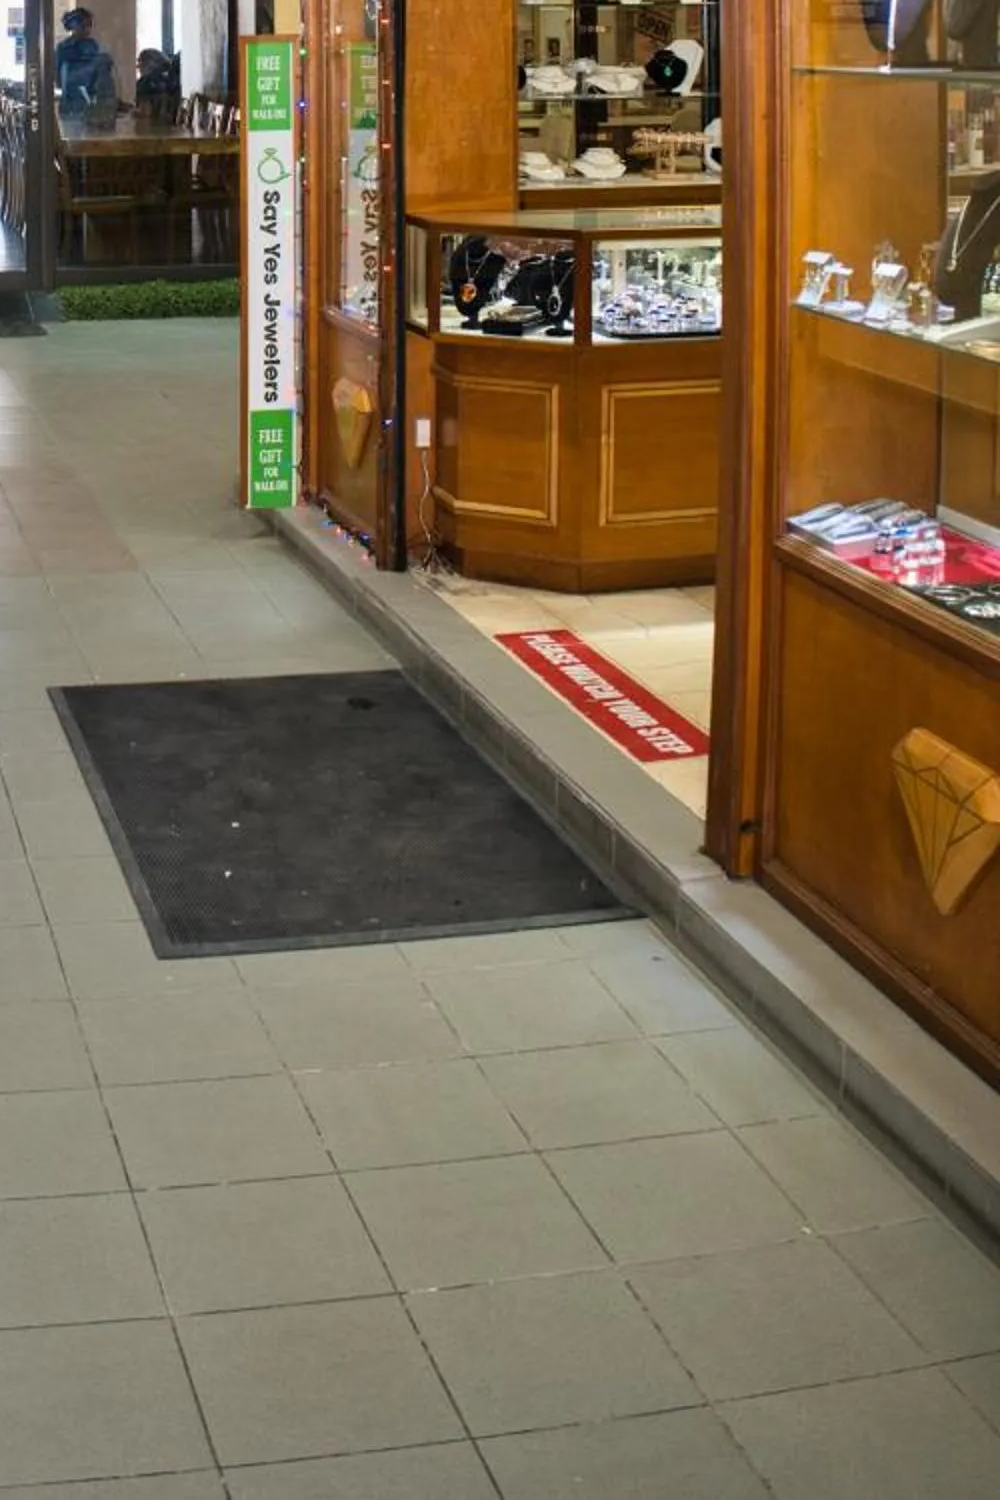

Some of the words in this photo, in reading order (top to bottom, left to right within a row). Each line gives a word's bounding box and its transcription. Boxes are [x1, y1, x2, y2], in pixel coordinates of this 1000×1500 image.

[256, 55, 281, 71] FREE
[256, 77, 281, 91] GIFT
[260, 190, 280, 235] Say
[263, 243, 281, 285] Yes
[263, 293, 281, 403] Jewelers
[257, 428, 283, 444] FREE
[259, 449, 282, 465] GIFT
[519, 633, 581, 666] PLEASE
[559, 663, 625, 700] WATCH
[602, 698, 660, 729] YOUR
[636, 727, 695, 755] STEP
